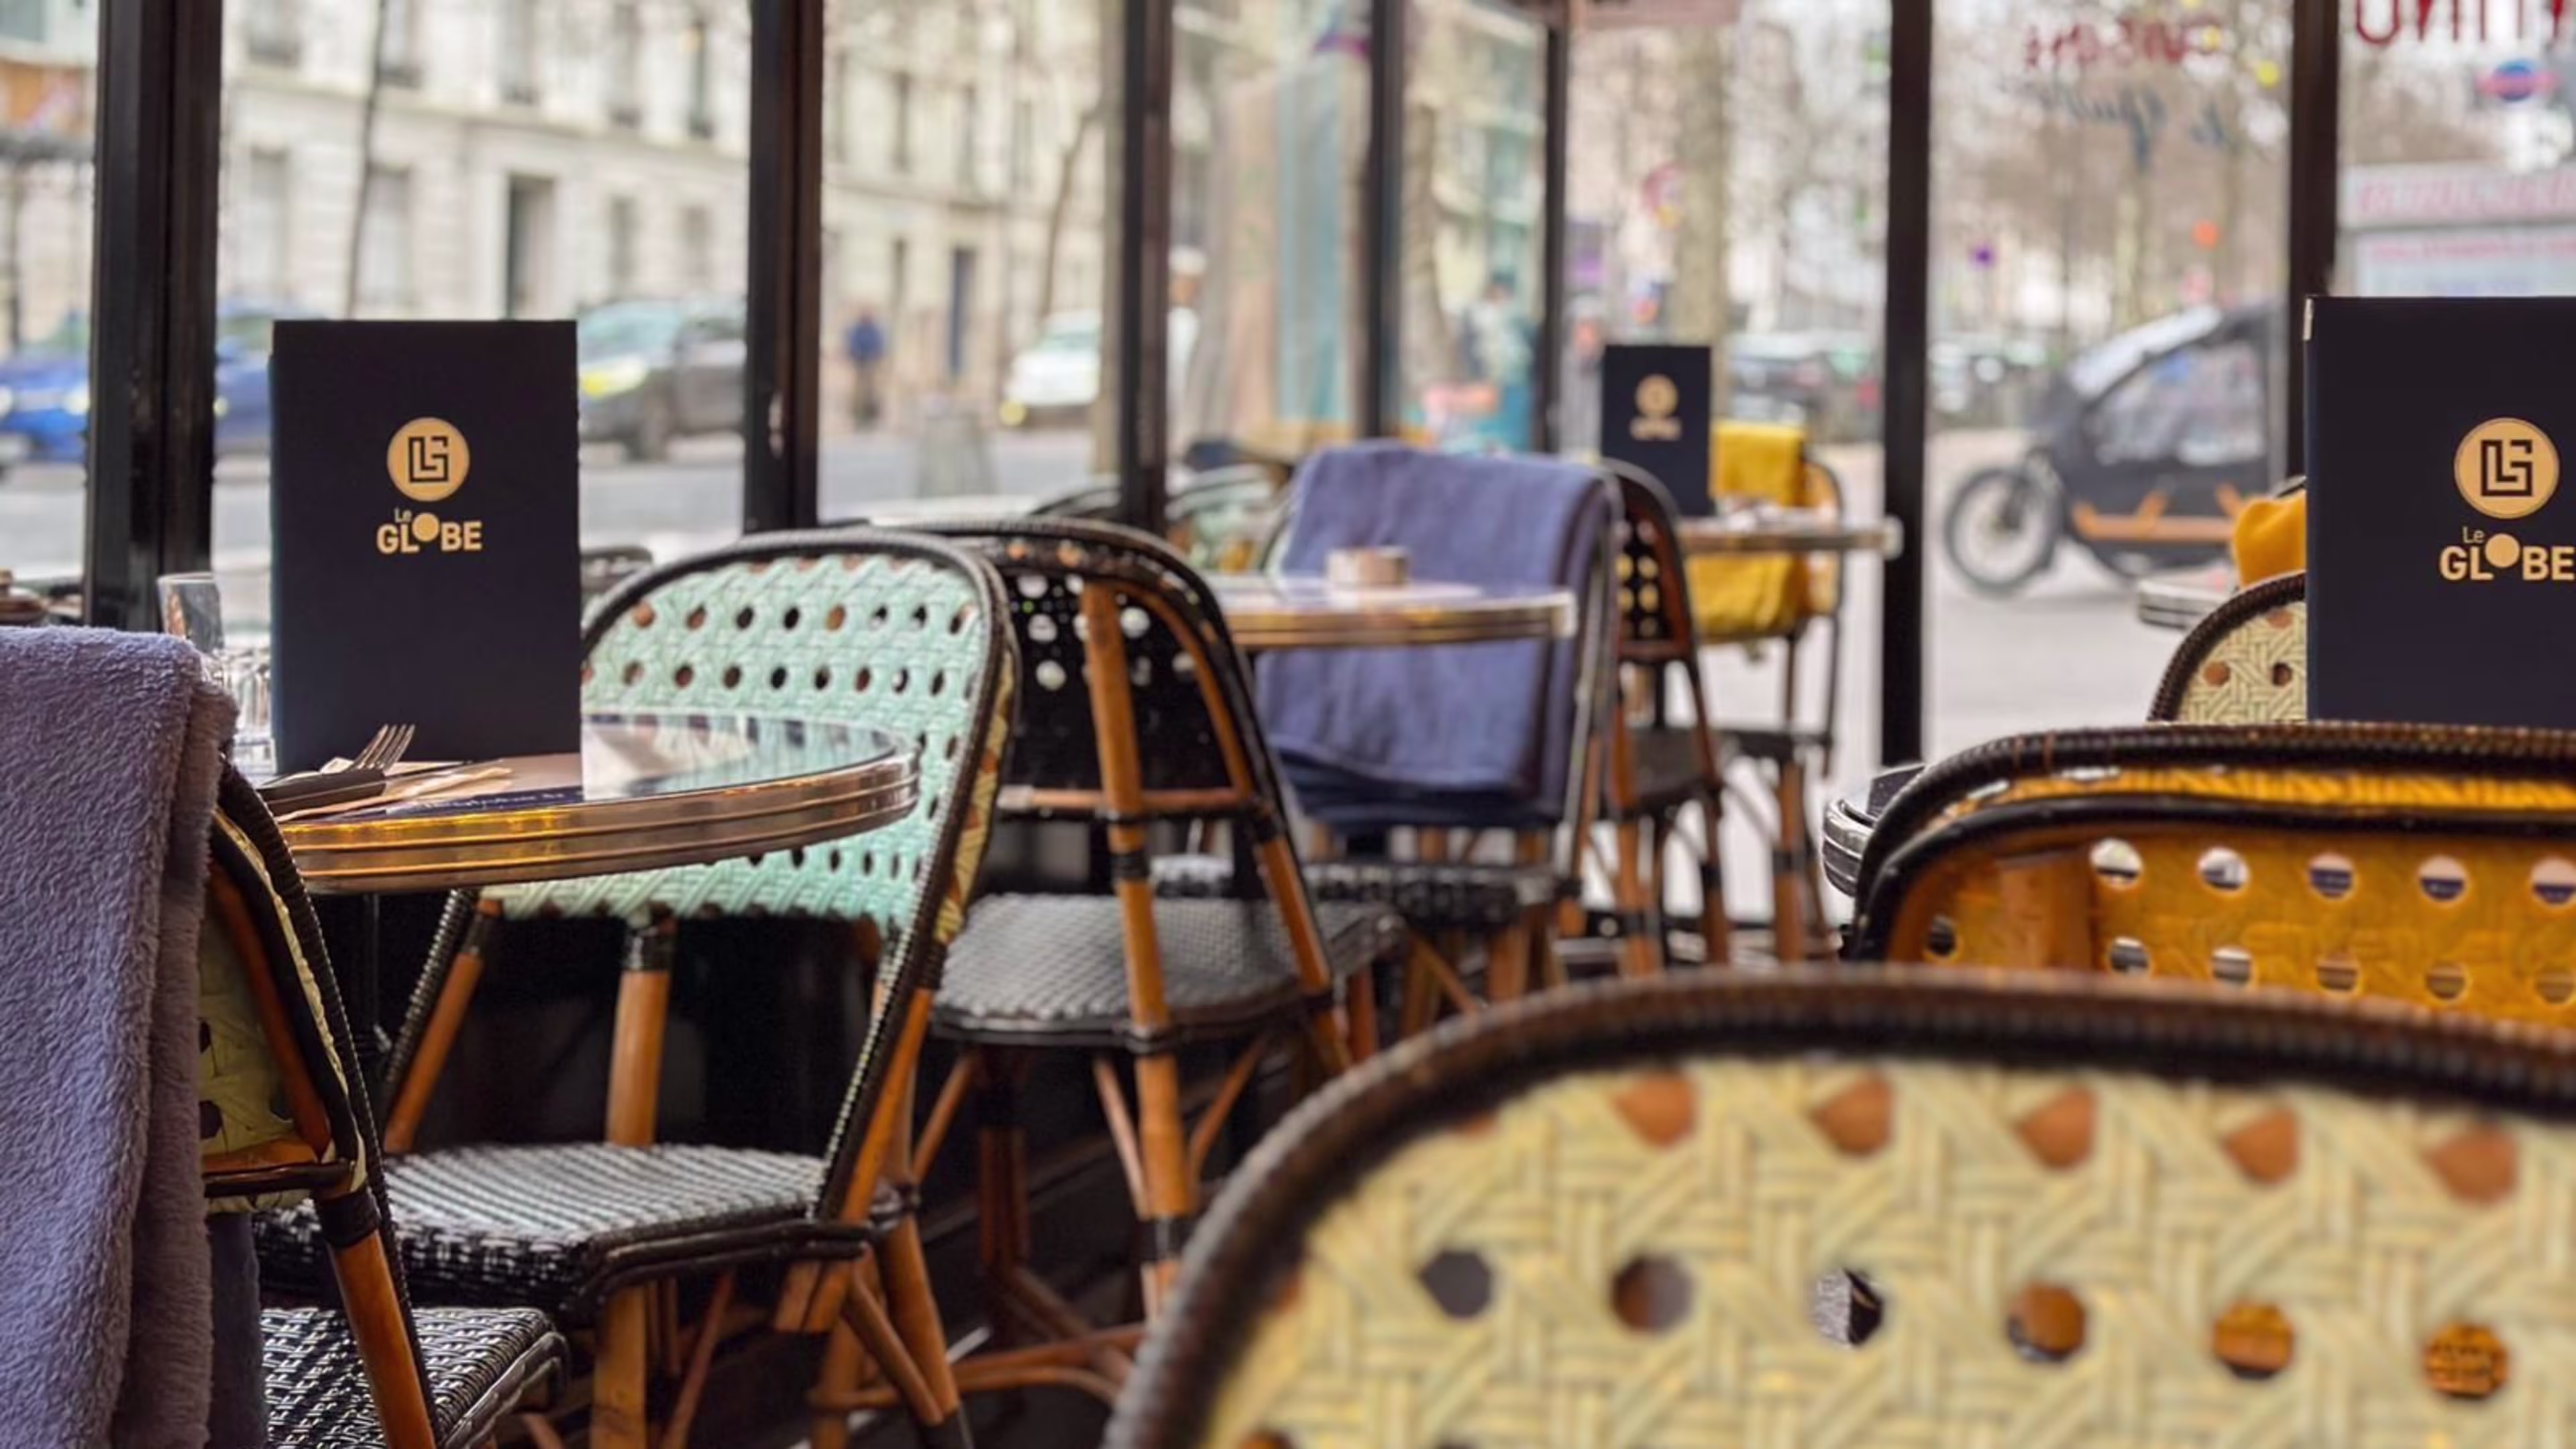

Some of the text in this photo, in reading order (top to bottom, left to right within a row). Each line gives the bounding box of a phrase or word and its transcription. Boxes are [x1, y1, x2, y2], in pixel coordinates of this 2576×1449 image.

[394, 507, 413, 523] Le
[376, 513, 482, 555] GLOBE
[2462, 527, 2485, 543] Le
[2440, 533, 2576, 580] GLOBE
